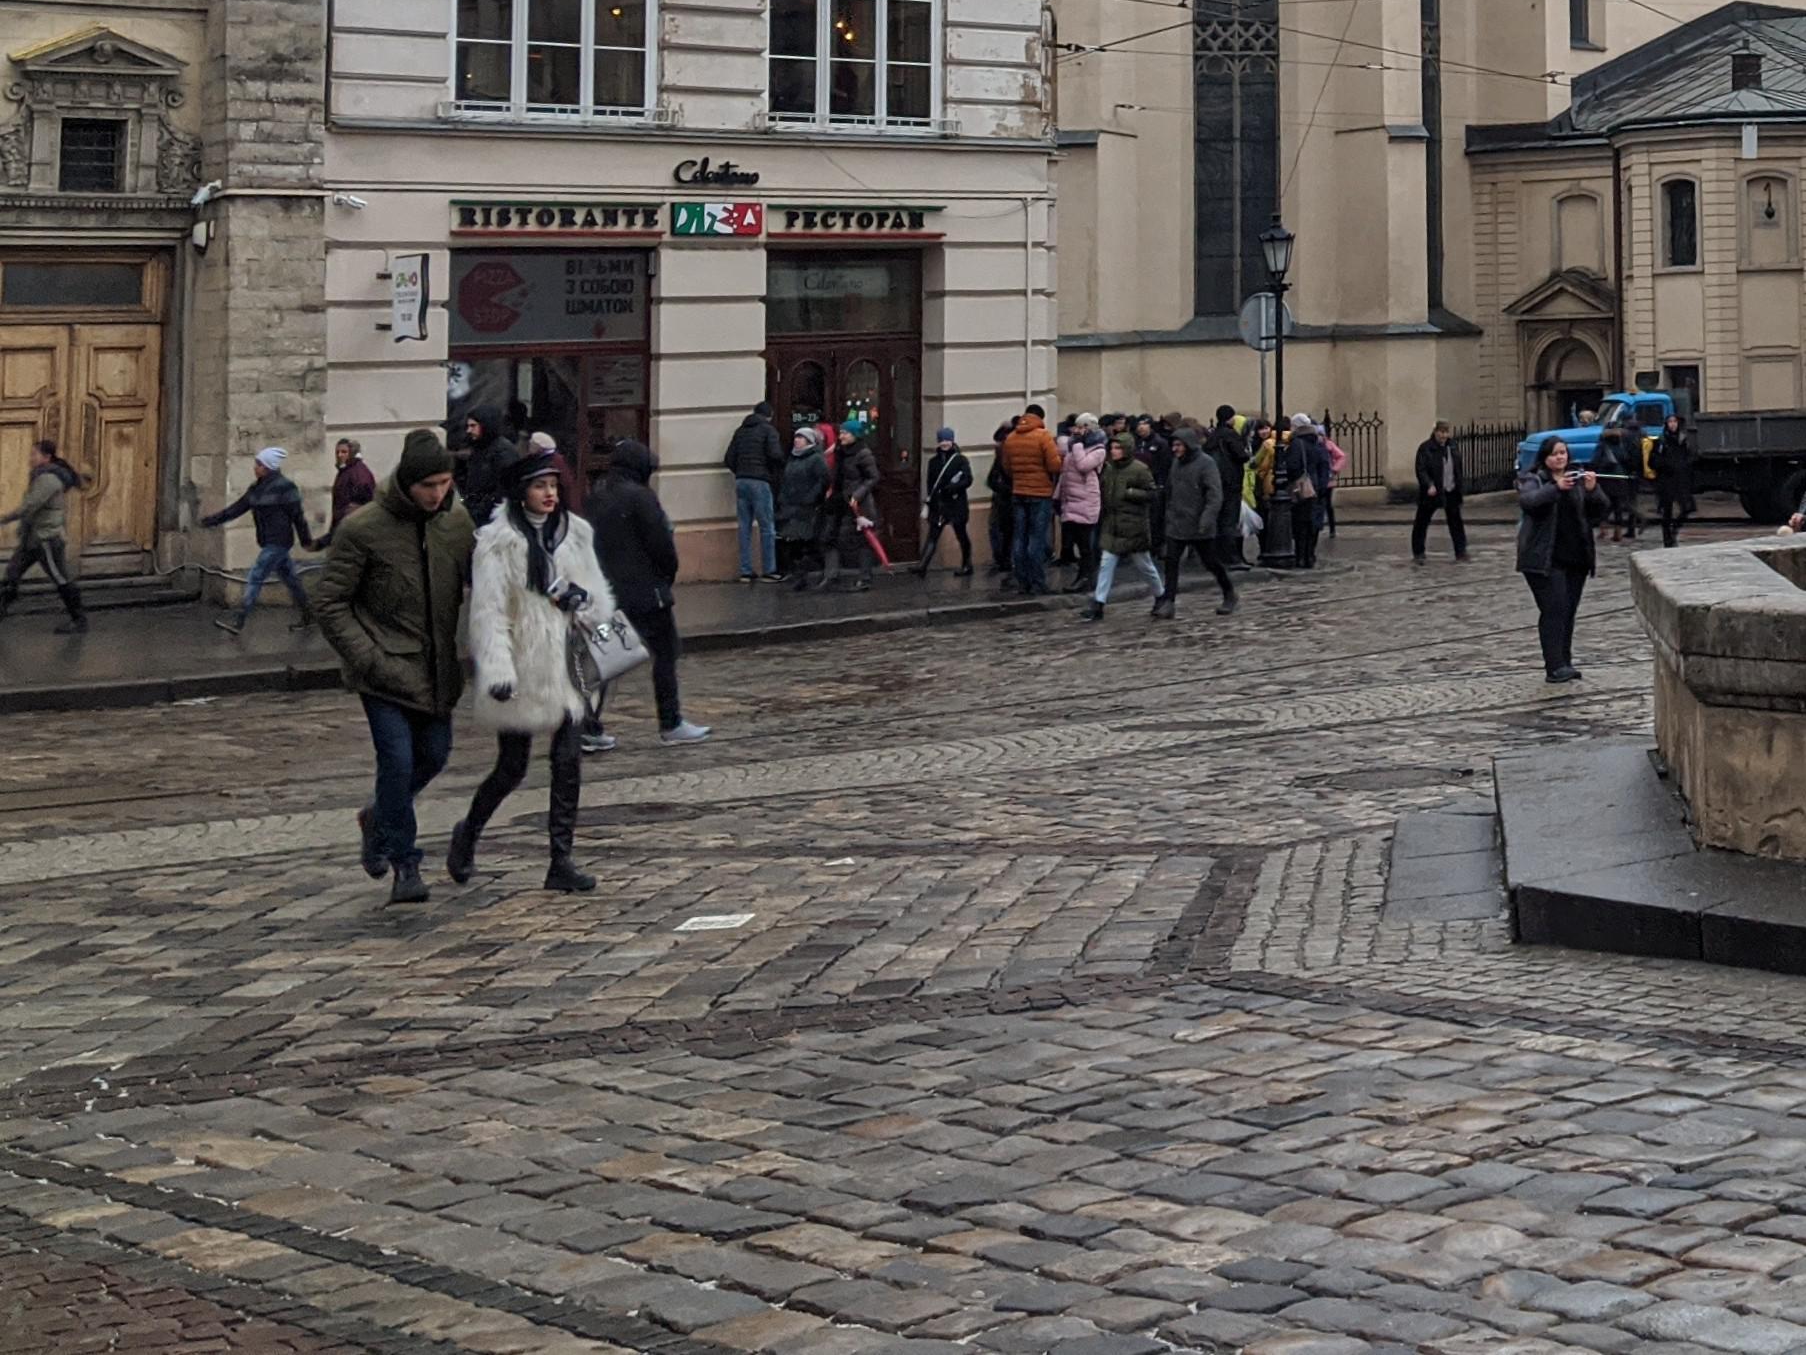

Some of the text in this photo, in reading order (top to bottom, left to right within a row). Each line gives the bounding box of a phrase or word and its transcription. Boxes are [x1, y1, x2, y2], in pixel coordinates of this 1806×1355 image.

[458, 206, 660, 228] RISTORANTE
[784, 210, 925, 230] РЕСТОРАН
[565, 259, 635, 275] ВІЬМИ
[580, 278, 635, 295] СОБОЮ
[565, 298, 635, 315] ШМАТОК
